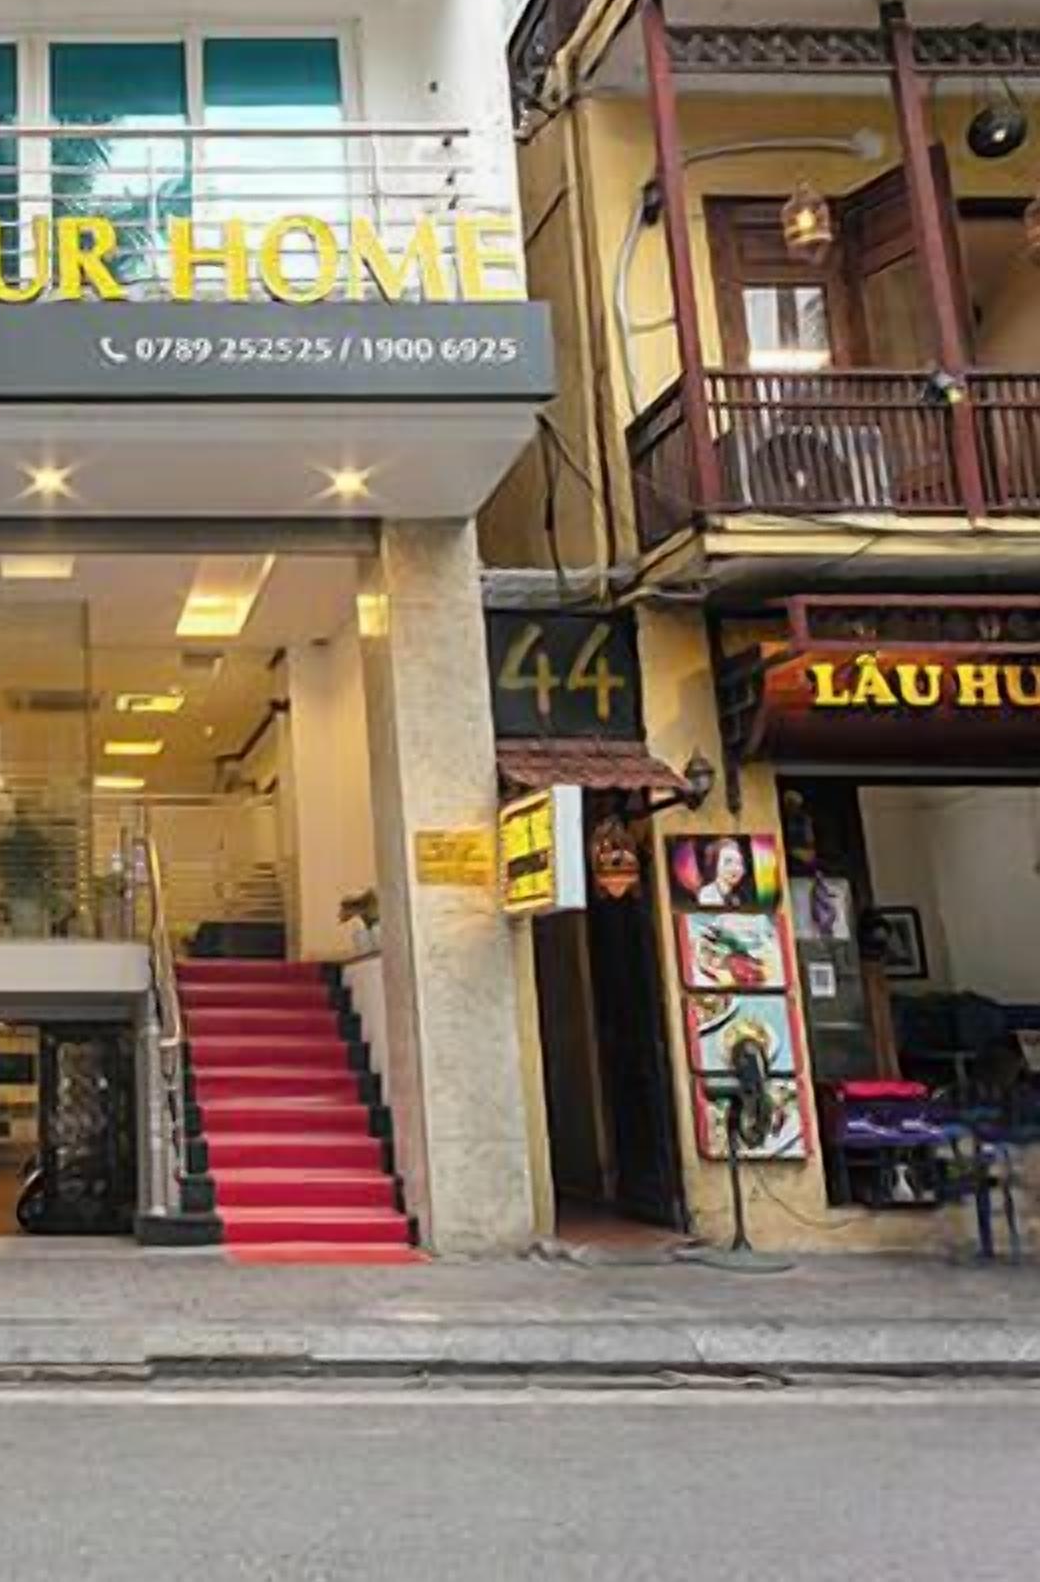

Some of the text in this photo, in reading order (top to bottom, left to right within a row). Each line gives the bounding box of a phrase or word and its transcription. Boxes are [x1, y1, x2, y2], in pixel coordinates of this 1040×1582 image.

[167, 214, 530, 305] HOME
[135, 336, 213, 363] 0789
[218, 336, 333, 363] 252525
[362, 336, 434, 363] 1900
[440, 336, 518, 363] 6925
[498, 623, 625, 722] 44
